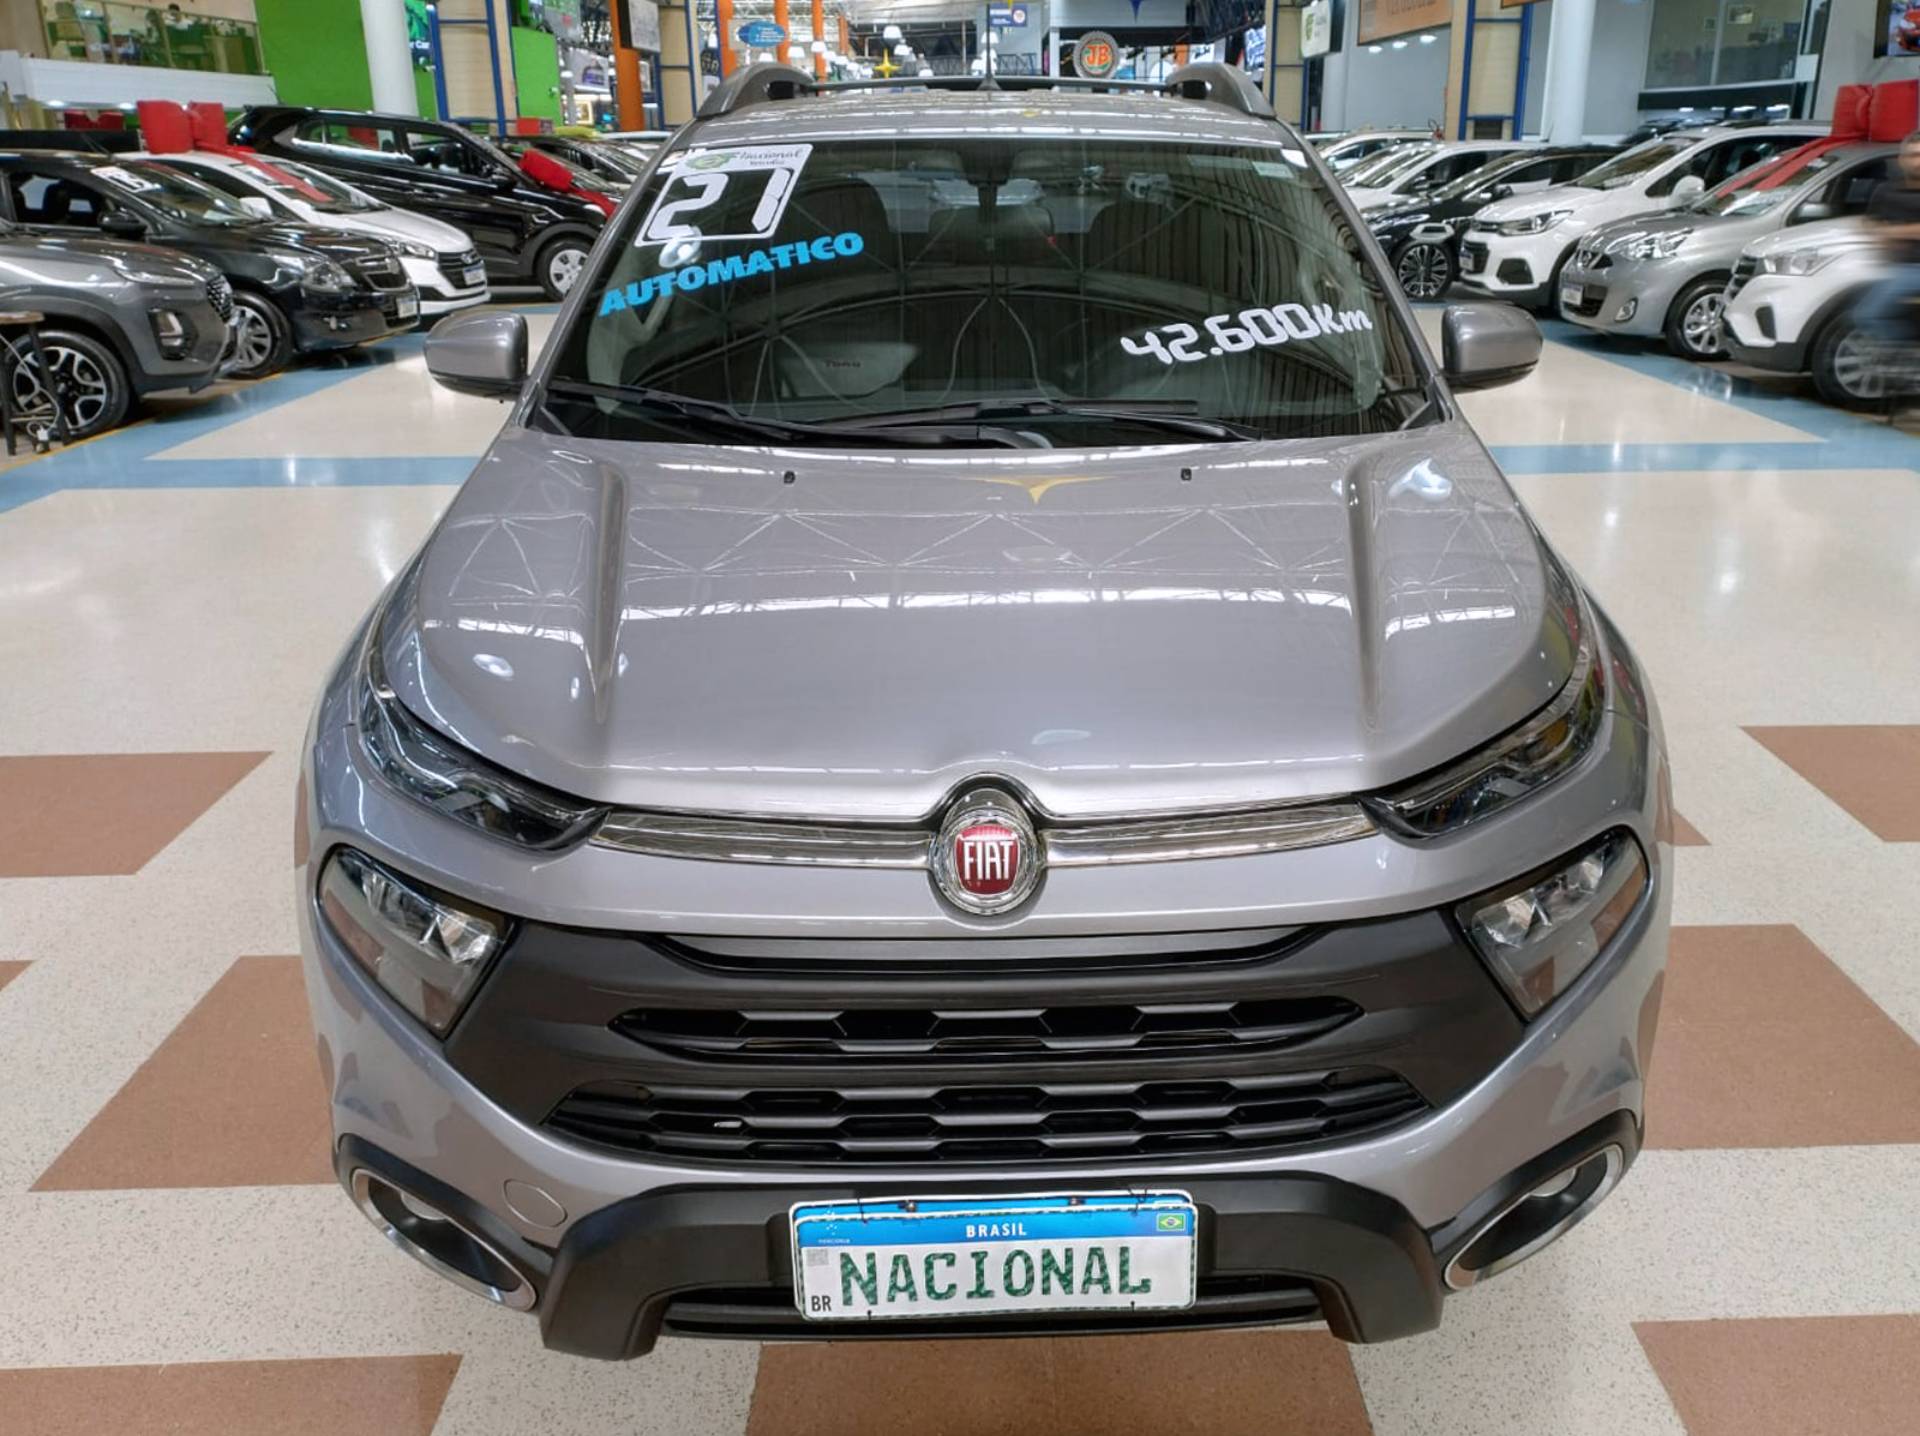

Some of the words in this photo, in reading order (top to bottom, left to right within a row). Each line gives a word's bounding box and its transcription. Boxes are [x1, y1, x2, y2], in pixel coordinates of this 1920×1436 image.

[1086, 44, 1110, 65] JB
[599, 232, 864, 316] AUTOMATICO
[963, 841, 1014, 880] FIAT
[966, 1222, 1027, 1238] BRASIL
[840, 1246, 1152, 1306] NACIONAL
[811, 1295, 832, 1312] BR
